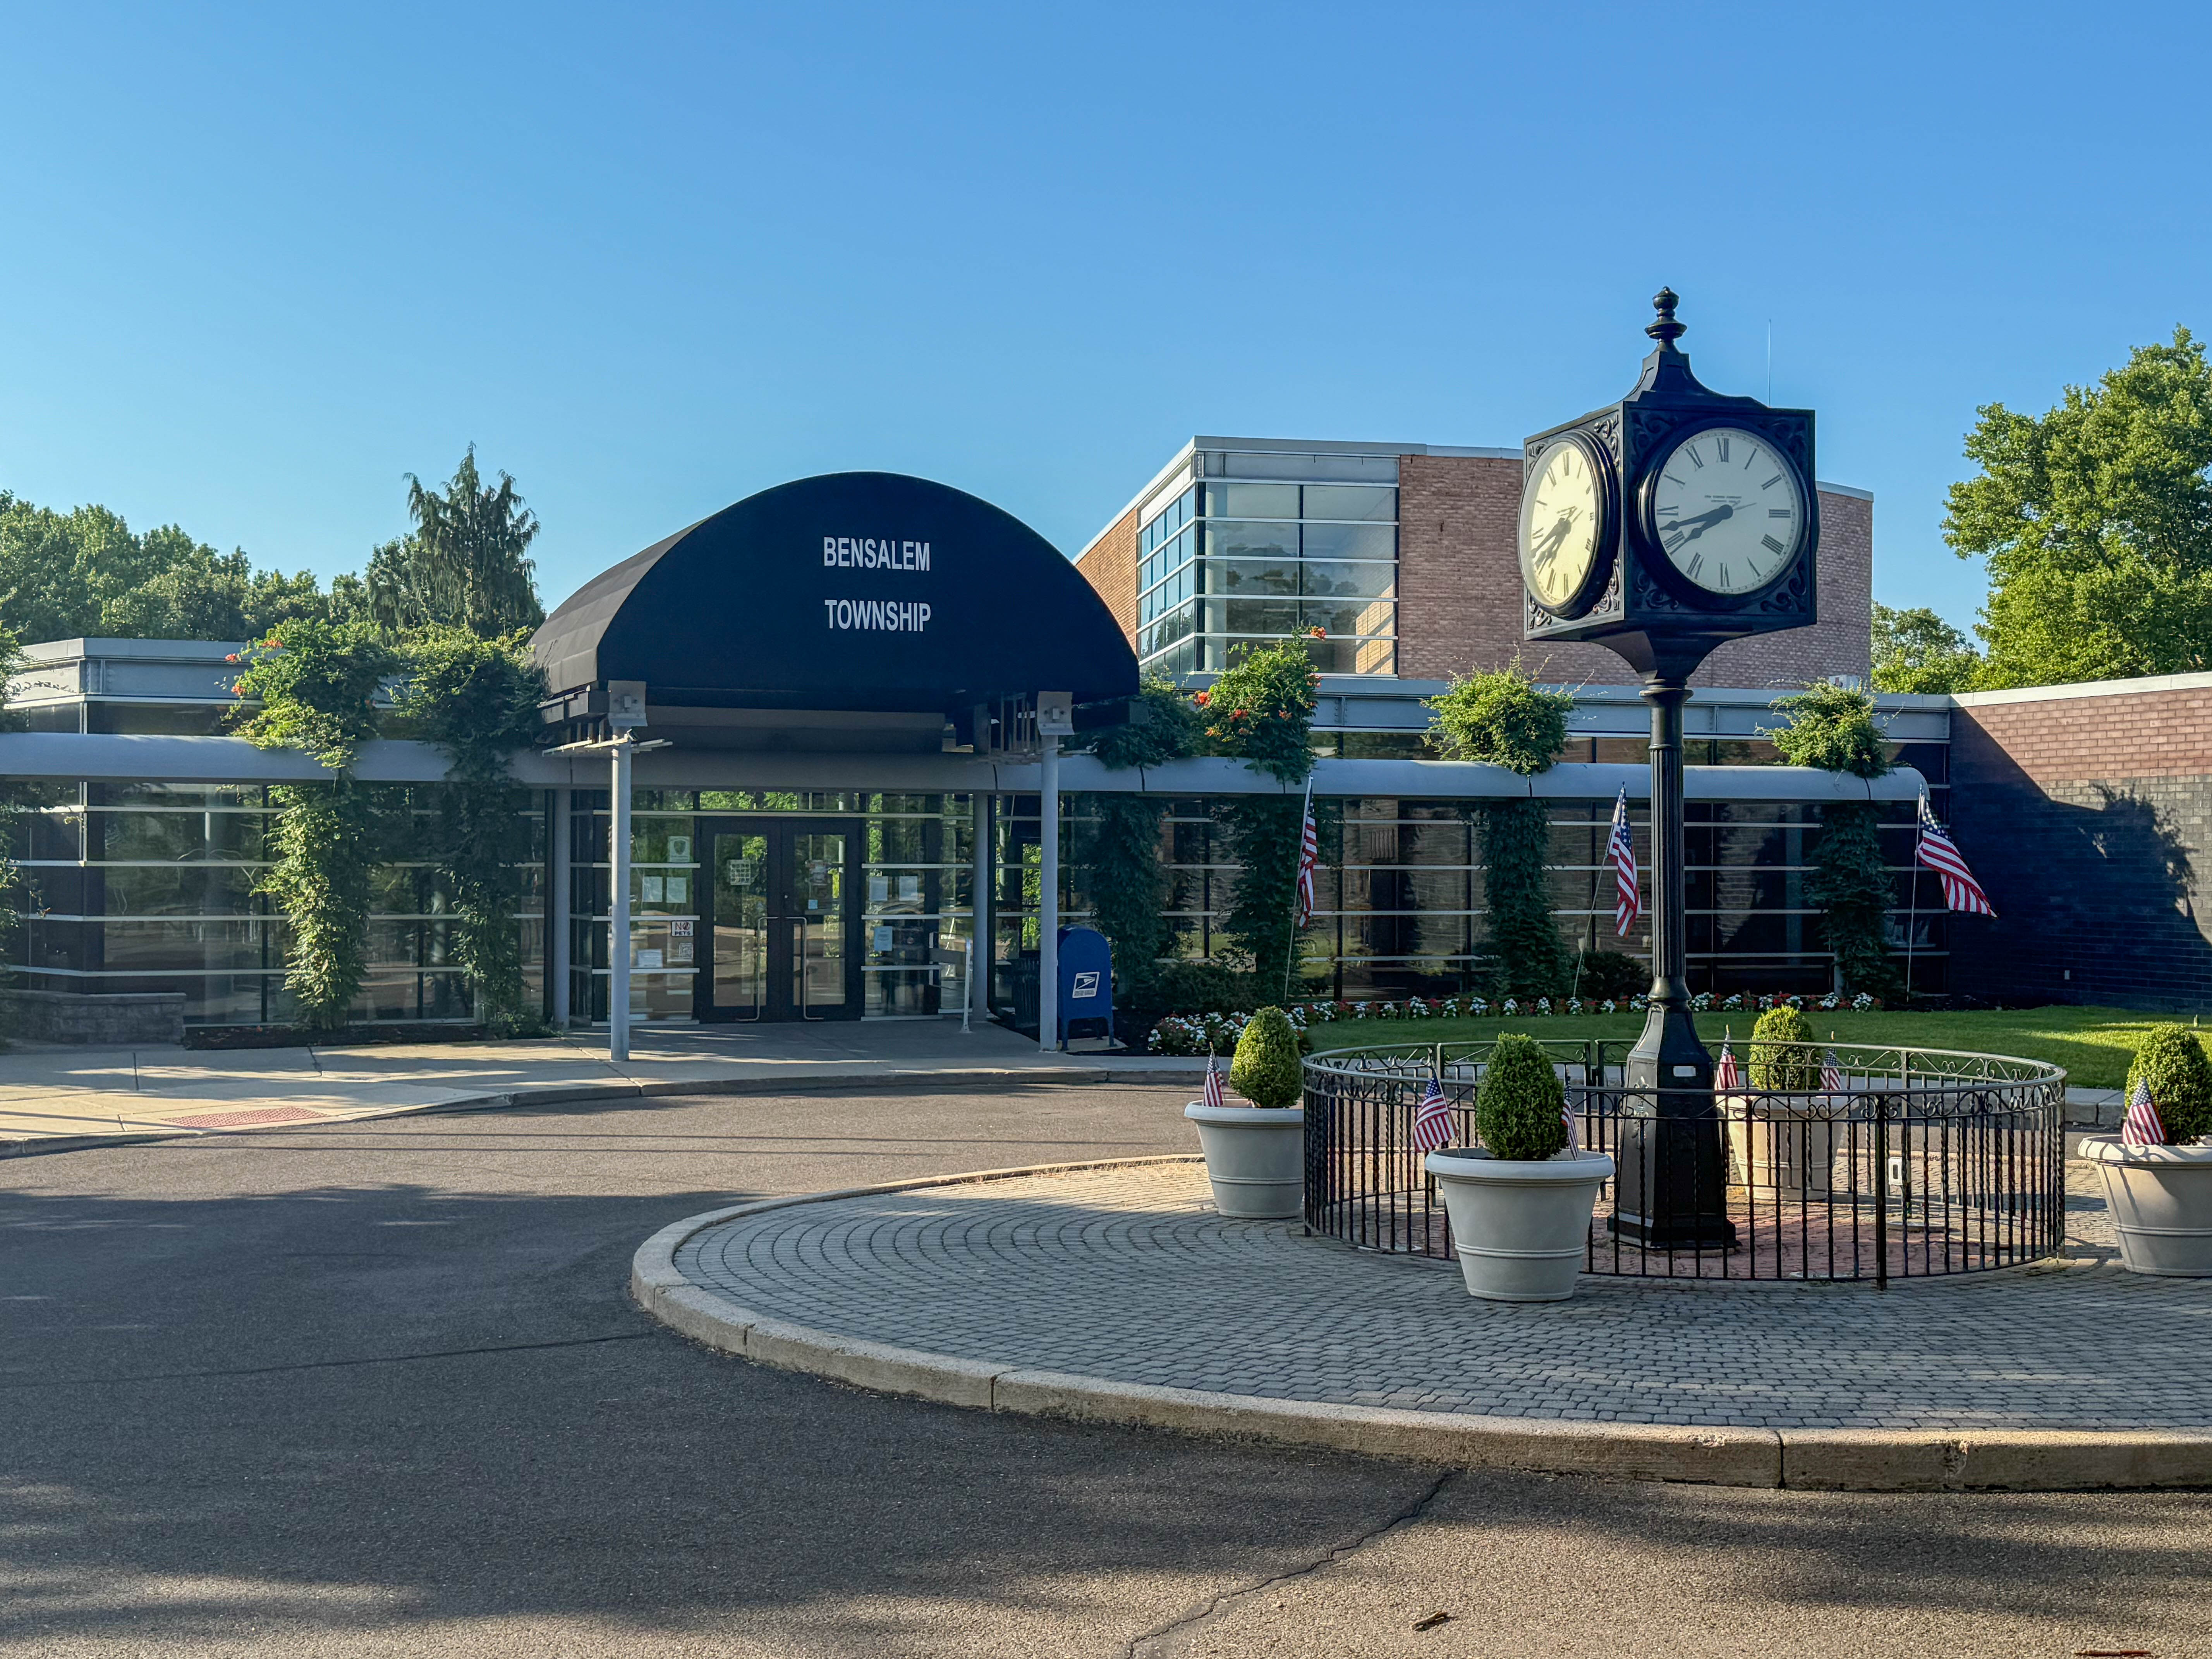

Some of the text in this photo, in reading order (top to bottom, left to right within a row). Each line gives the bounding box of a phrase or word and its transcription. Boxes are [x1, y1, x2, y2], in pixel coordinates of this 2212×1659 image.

[1716, 438, 1729, 463] XII
[1769, 509, 1791, 518] III
[824, 537, 930, 571] BENSALEM
[824, 599, 931, 632] TOWNSHIP
[675, 922, 690, 930] NO
